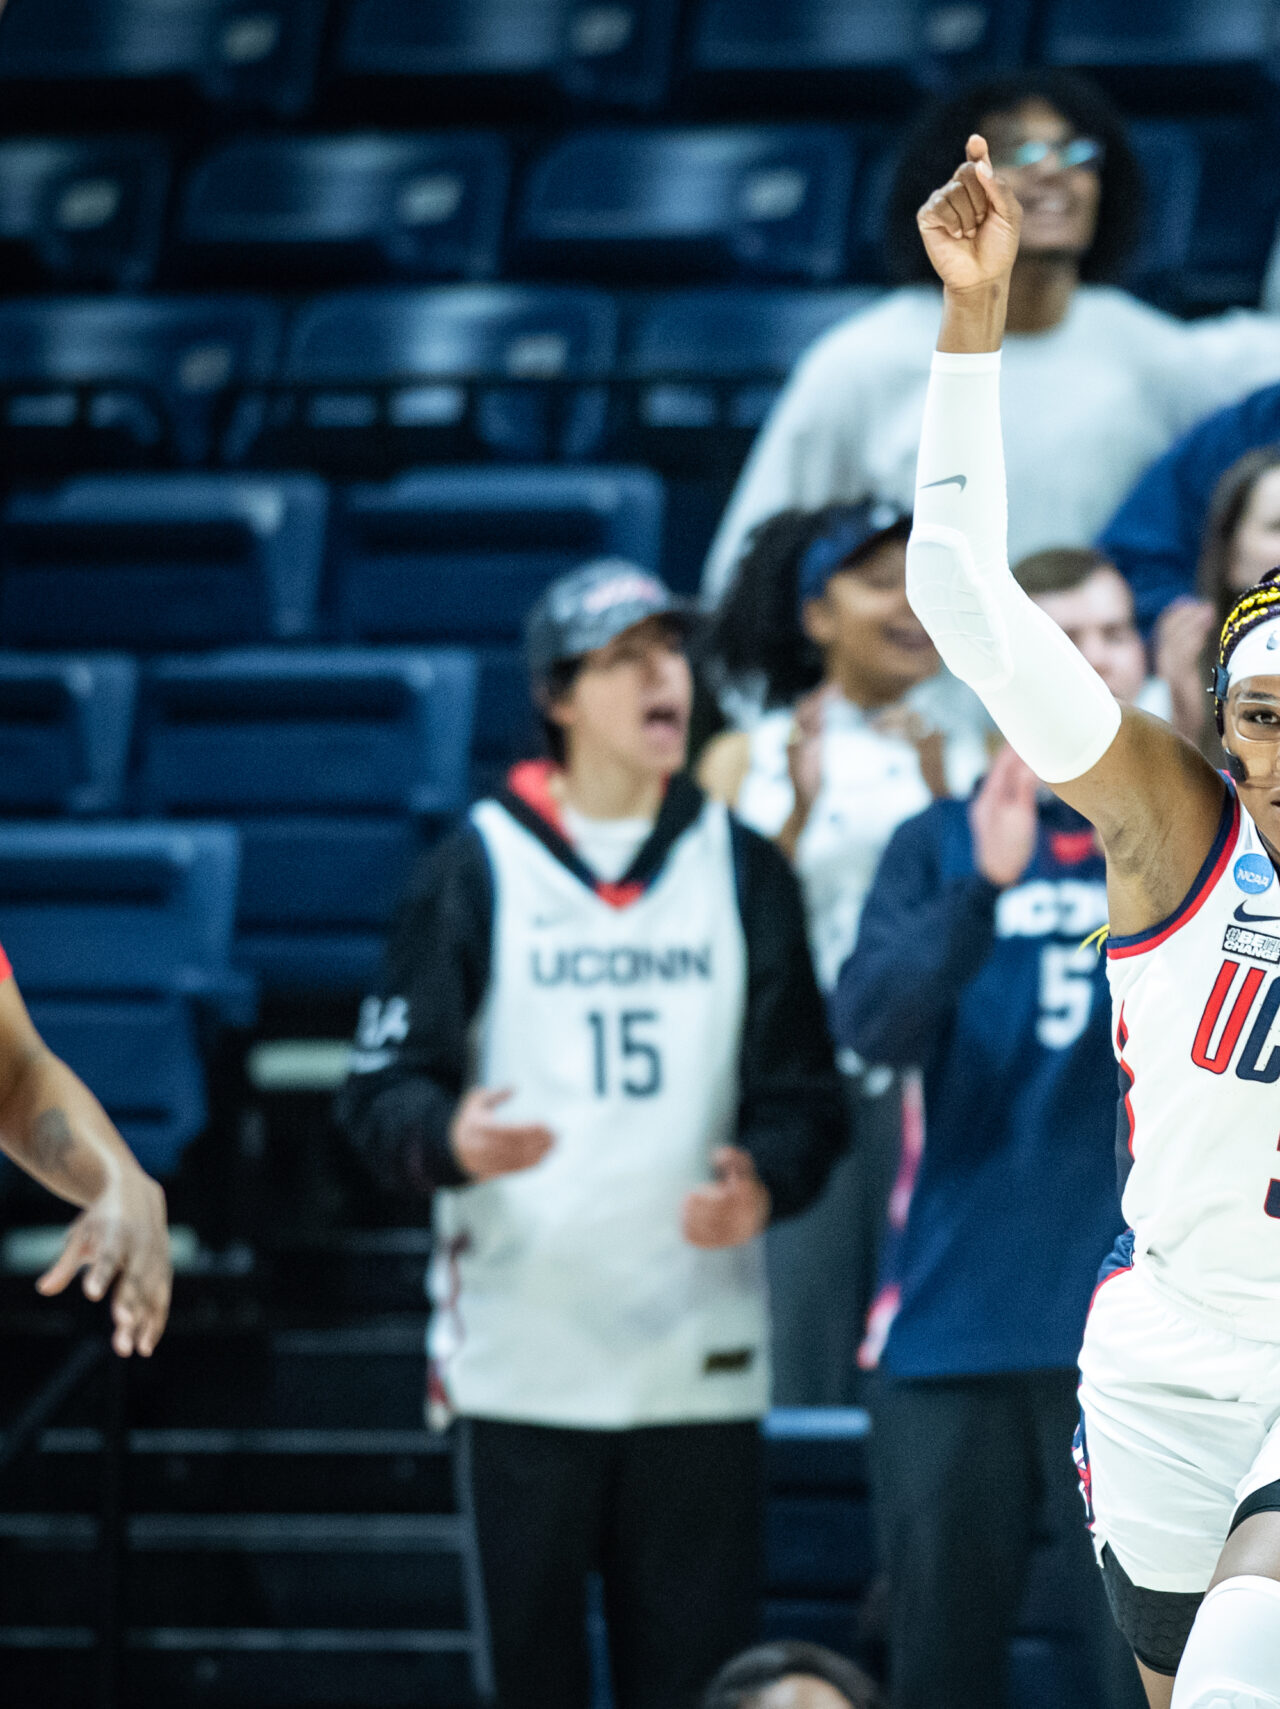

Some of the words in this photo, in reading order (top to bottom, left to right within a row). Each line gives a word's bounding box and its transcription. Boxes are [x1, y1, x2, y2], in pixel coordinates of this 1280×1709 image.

[1236, 868, 1270, 888] NCAA
[530, 939, 714, 989] UCONN
[1223, 940, 1280, 963] CHANGE
[1036, 943, 1100, 1051] 5
[585, 1007, 664, 1100] 15
